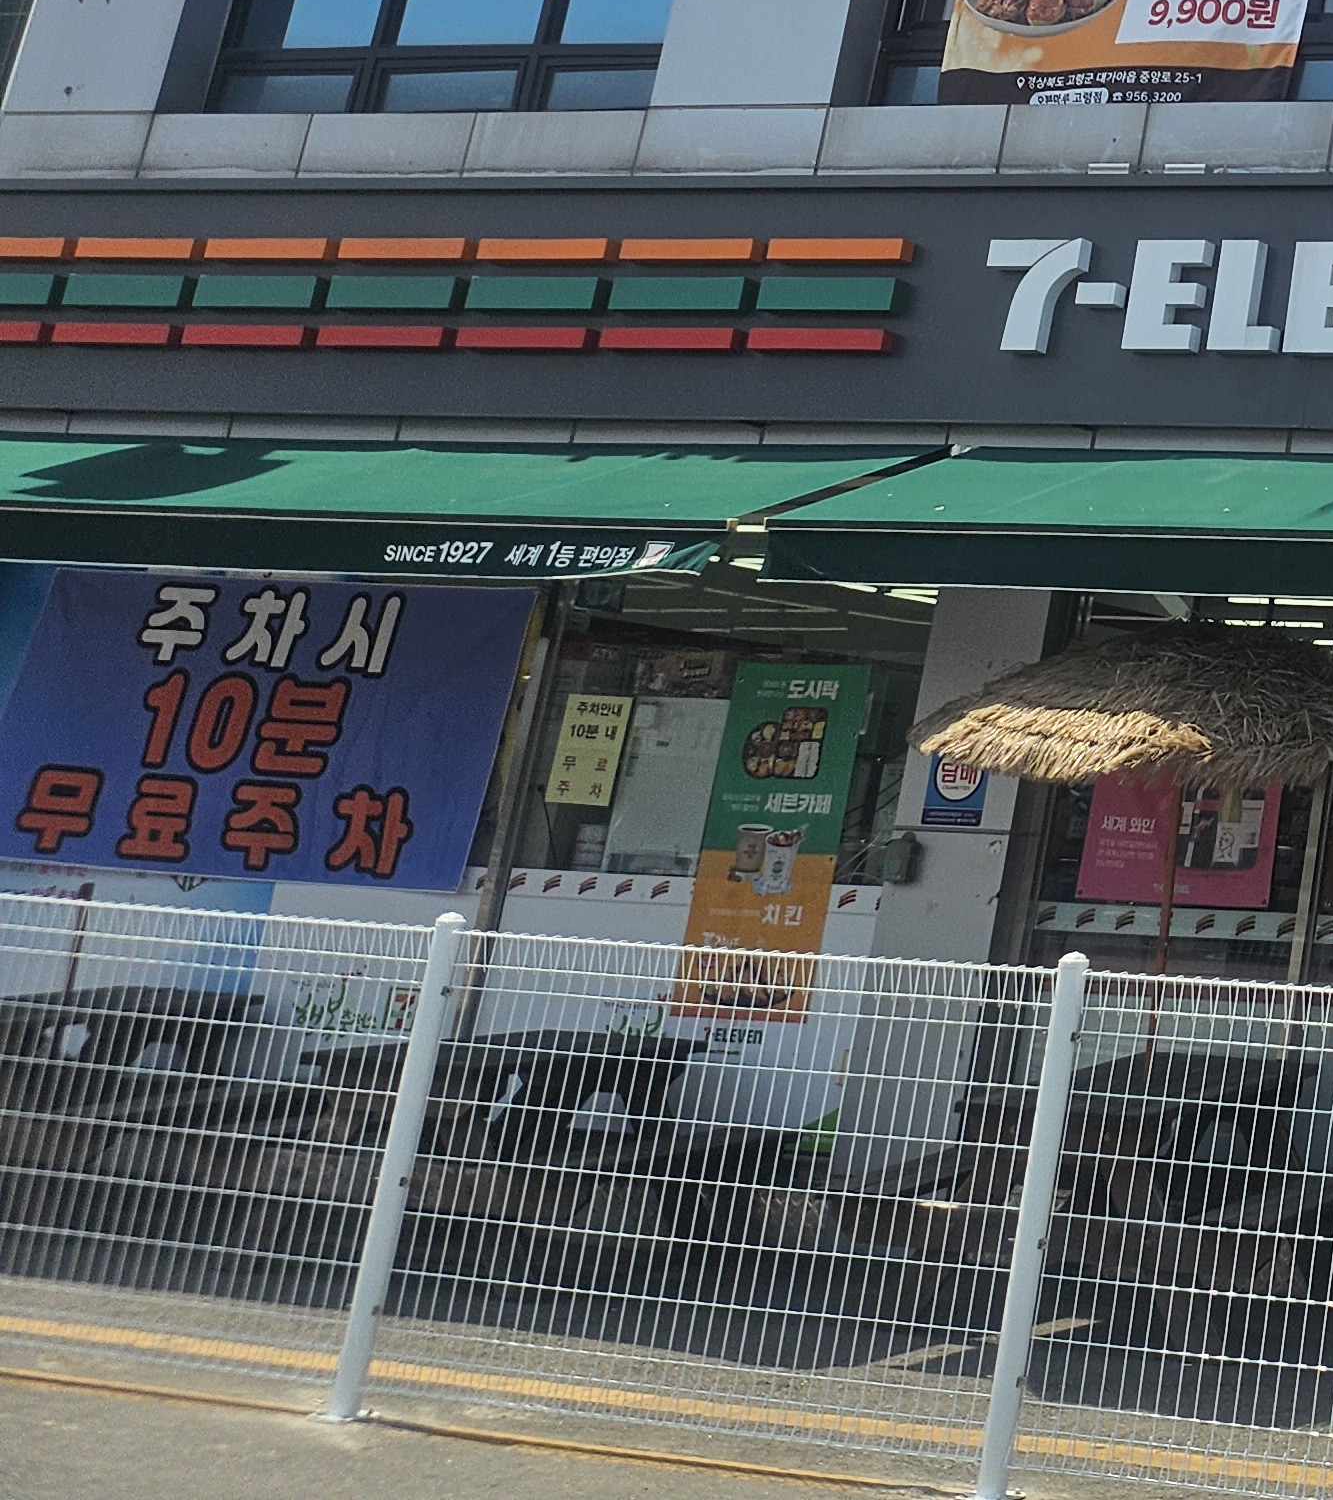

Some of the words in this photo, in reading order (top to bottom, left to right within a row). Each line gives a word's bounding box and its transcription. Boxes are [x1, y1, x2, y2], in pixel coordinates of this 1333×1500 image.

[1027, 76, 1065, 89] 경상북도
[1066, 73, 1095, 86] 고령군
[1096, 71, 1137, 84] 대가야읍
[1139, 70, 1172, 84] 중앙로
[1174, 73, 1202, 83] 25-1
[1126, 91, 1182, 104] 956.3200
[504, 543, 545, 566] 세계
[546, 540, 576, 567] 1등
[578, 545, 636, 569] 편의점
[139, 585, 402, 675] 주차시
[787, 679, 840, 701] 도시락
[577, 701, 625, 718] 주차안내
[141, 673, 350, 775] 10분
[570, 723, 599, 739] 10분
[764, 792, 833, 815] 세븐카페
[1101, 815, 1127, 833] 세계
[1128, 817, 1156, 834] 와인
[762, 903, 803, 926] 치킨
